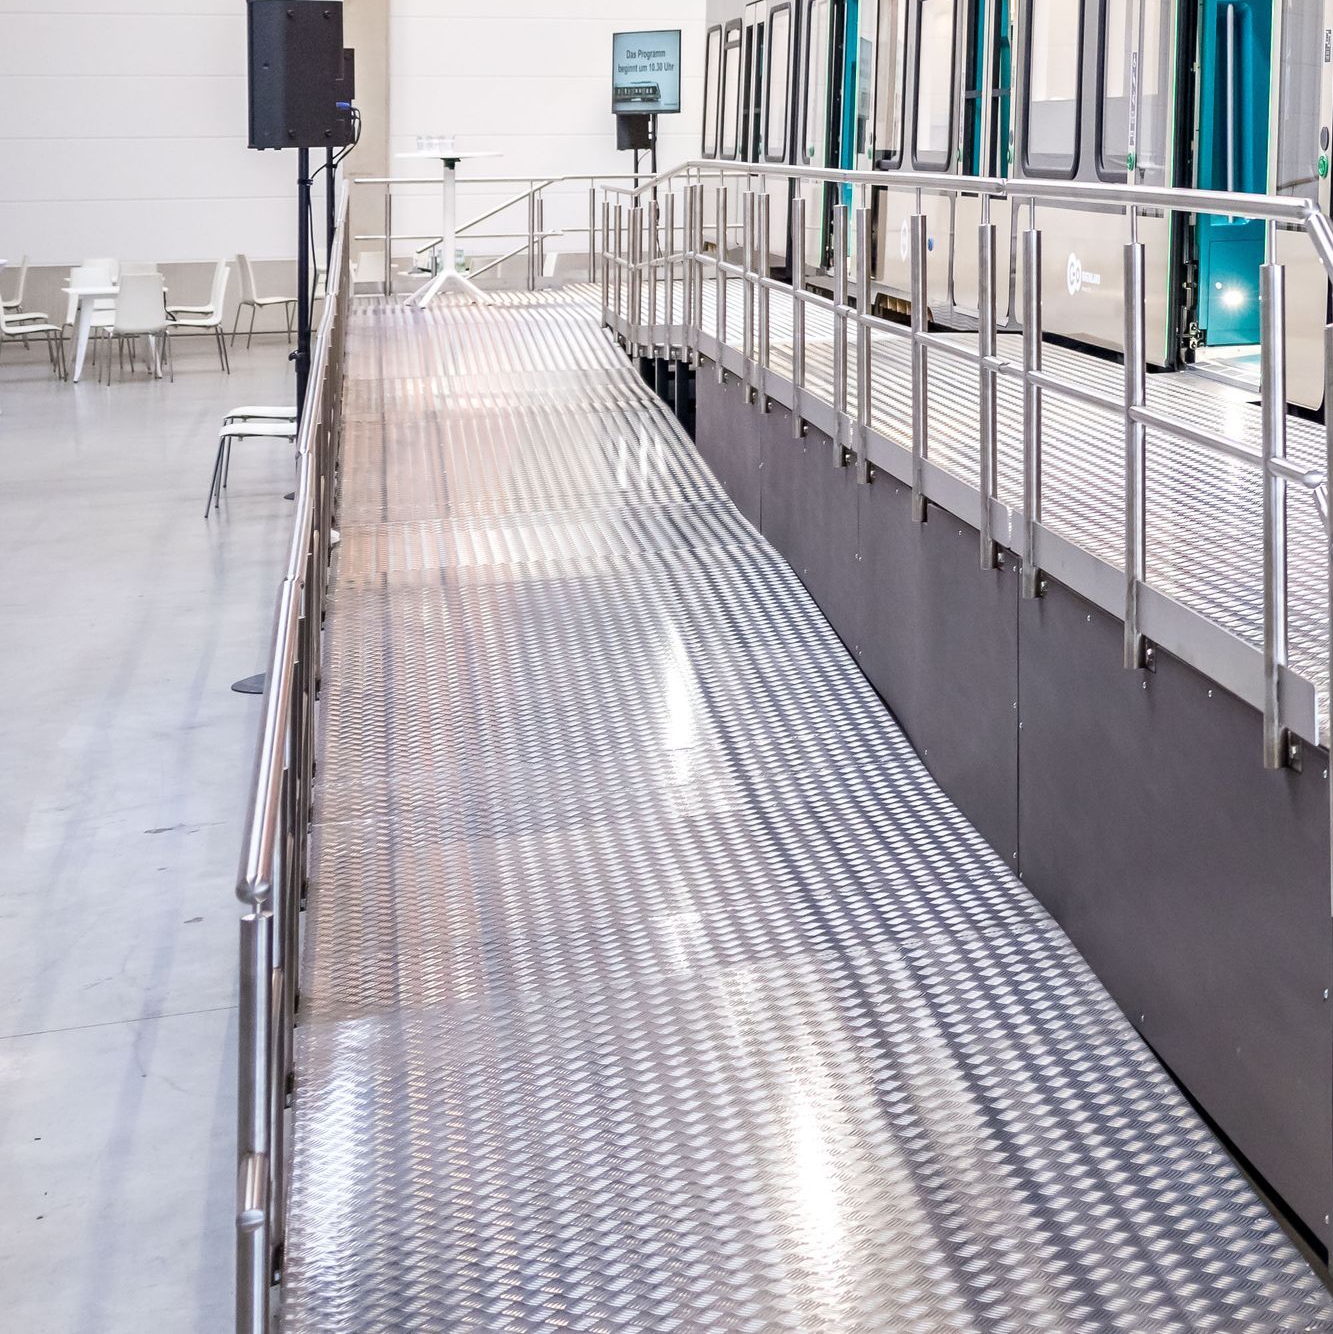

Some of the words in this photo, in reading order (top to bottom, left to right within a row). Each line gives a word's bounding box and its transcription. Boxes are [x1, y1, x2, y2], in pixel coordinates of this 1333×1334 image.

[626, 49, 637, 59] Das
[638, 49, 666, 61] Programm
[617, 63, 638, 75] beginnt
[639, 65, 648, 73] um
